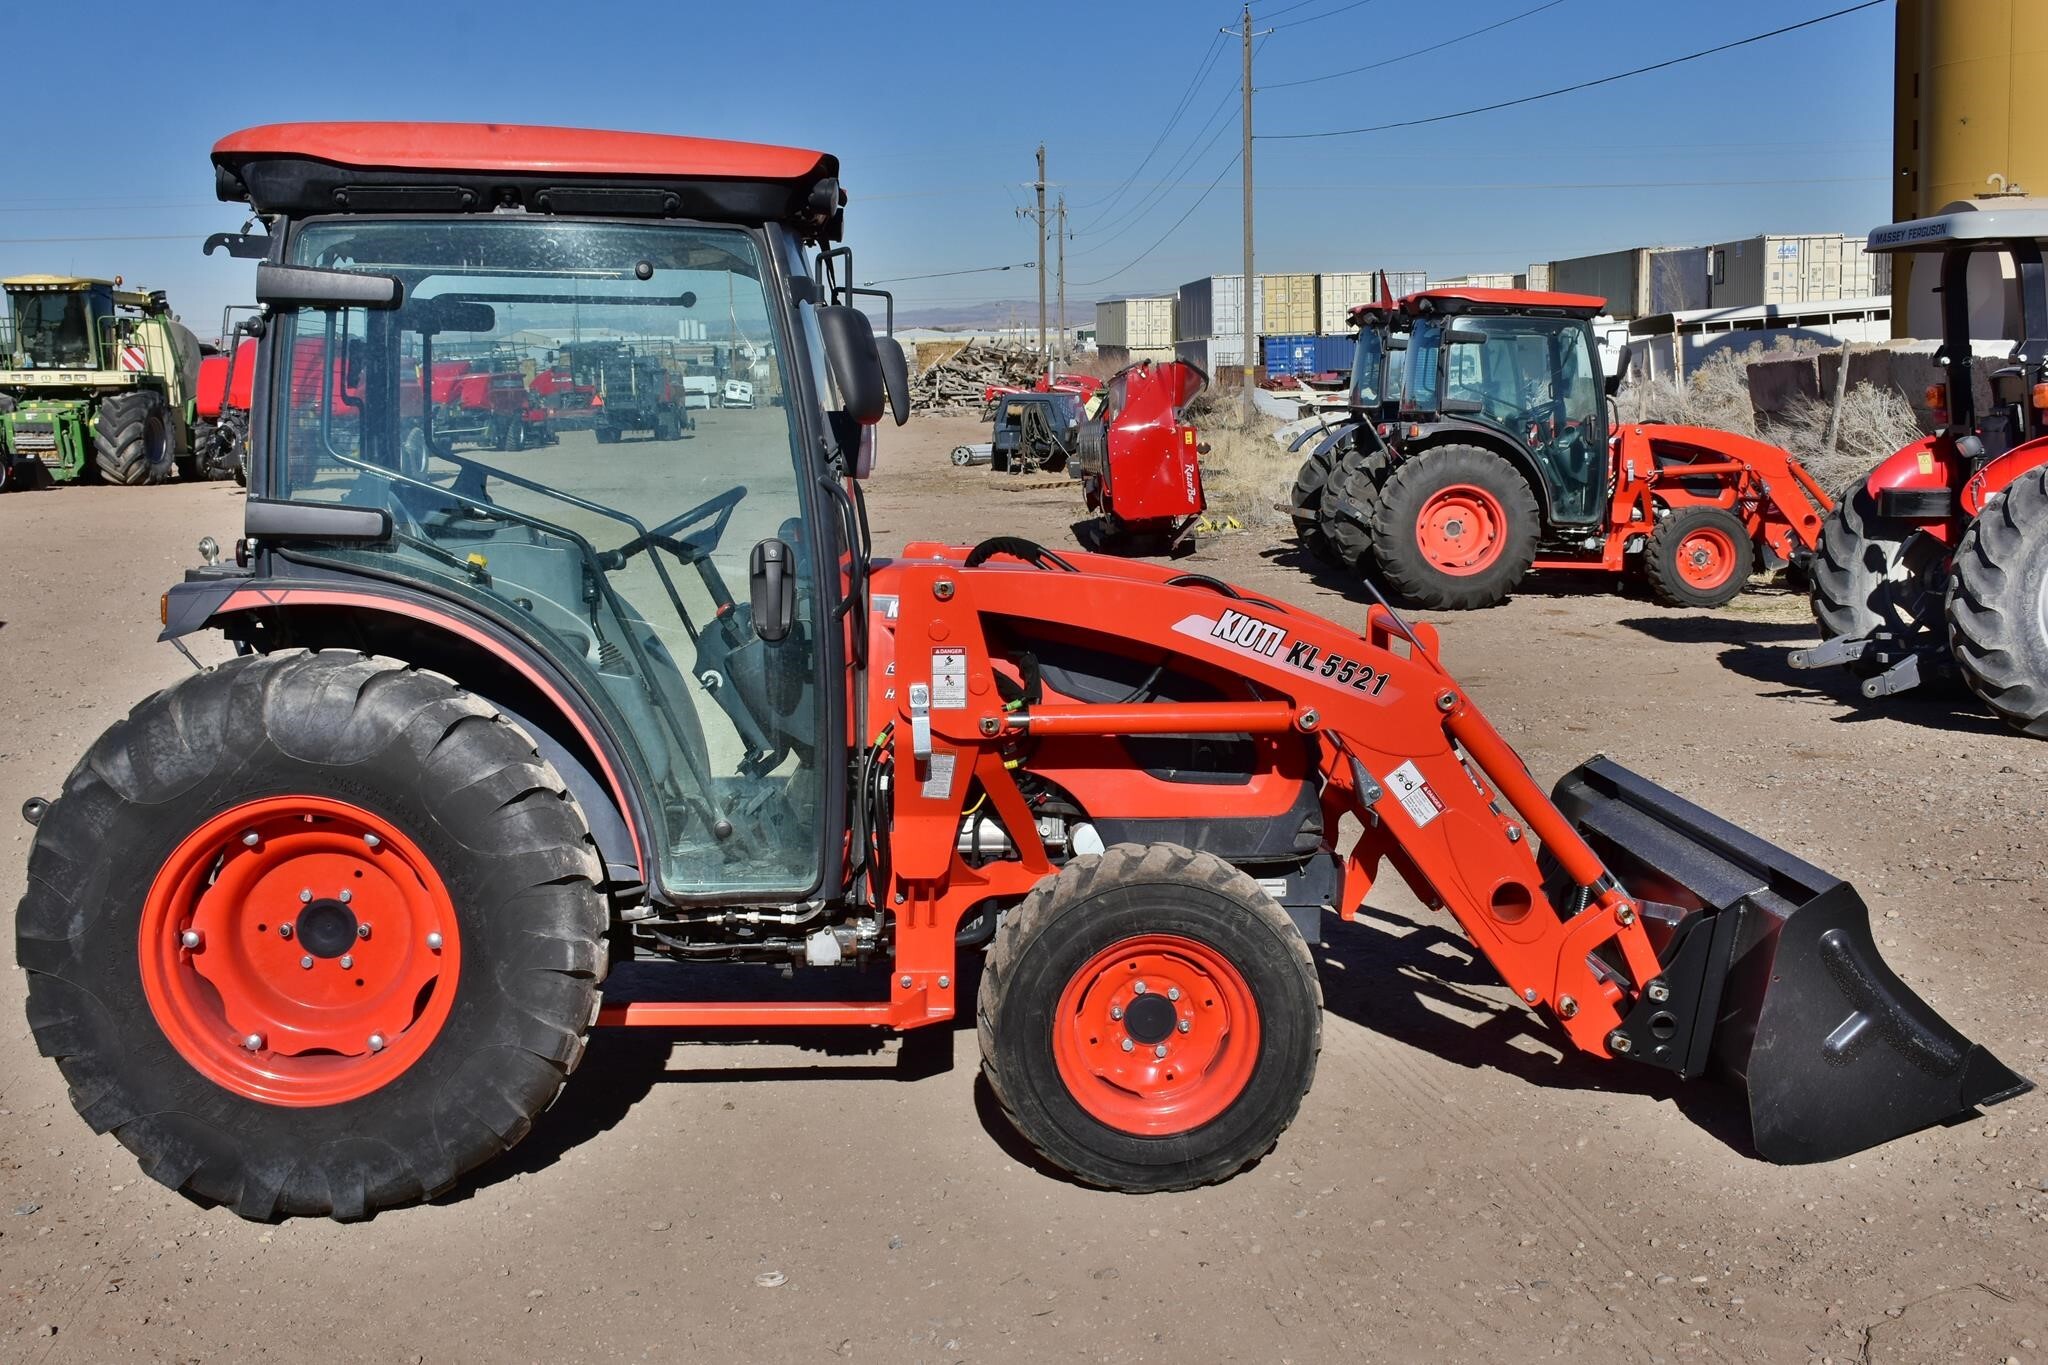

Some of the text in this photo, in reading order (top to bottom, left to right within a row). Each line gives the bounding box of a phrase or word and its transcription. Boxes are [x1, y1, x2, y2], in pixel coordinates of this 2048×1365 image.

[1876, 223, 1947, 244] MASSEY FERGUSON
[1210, 607, 1390, 696] KIOTI KL 5521
[1426, 788, 1443, 809] DANGER
